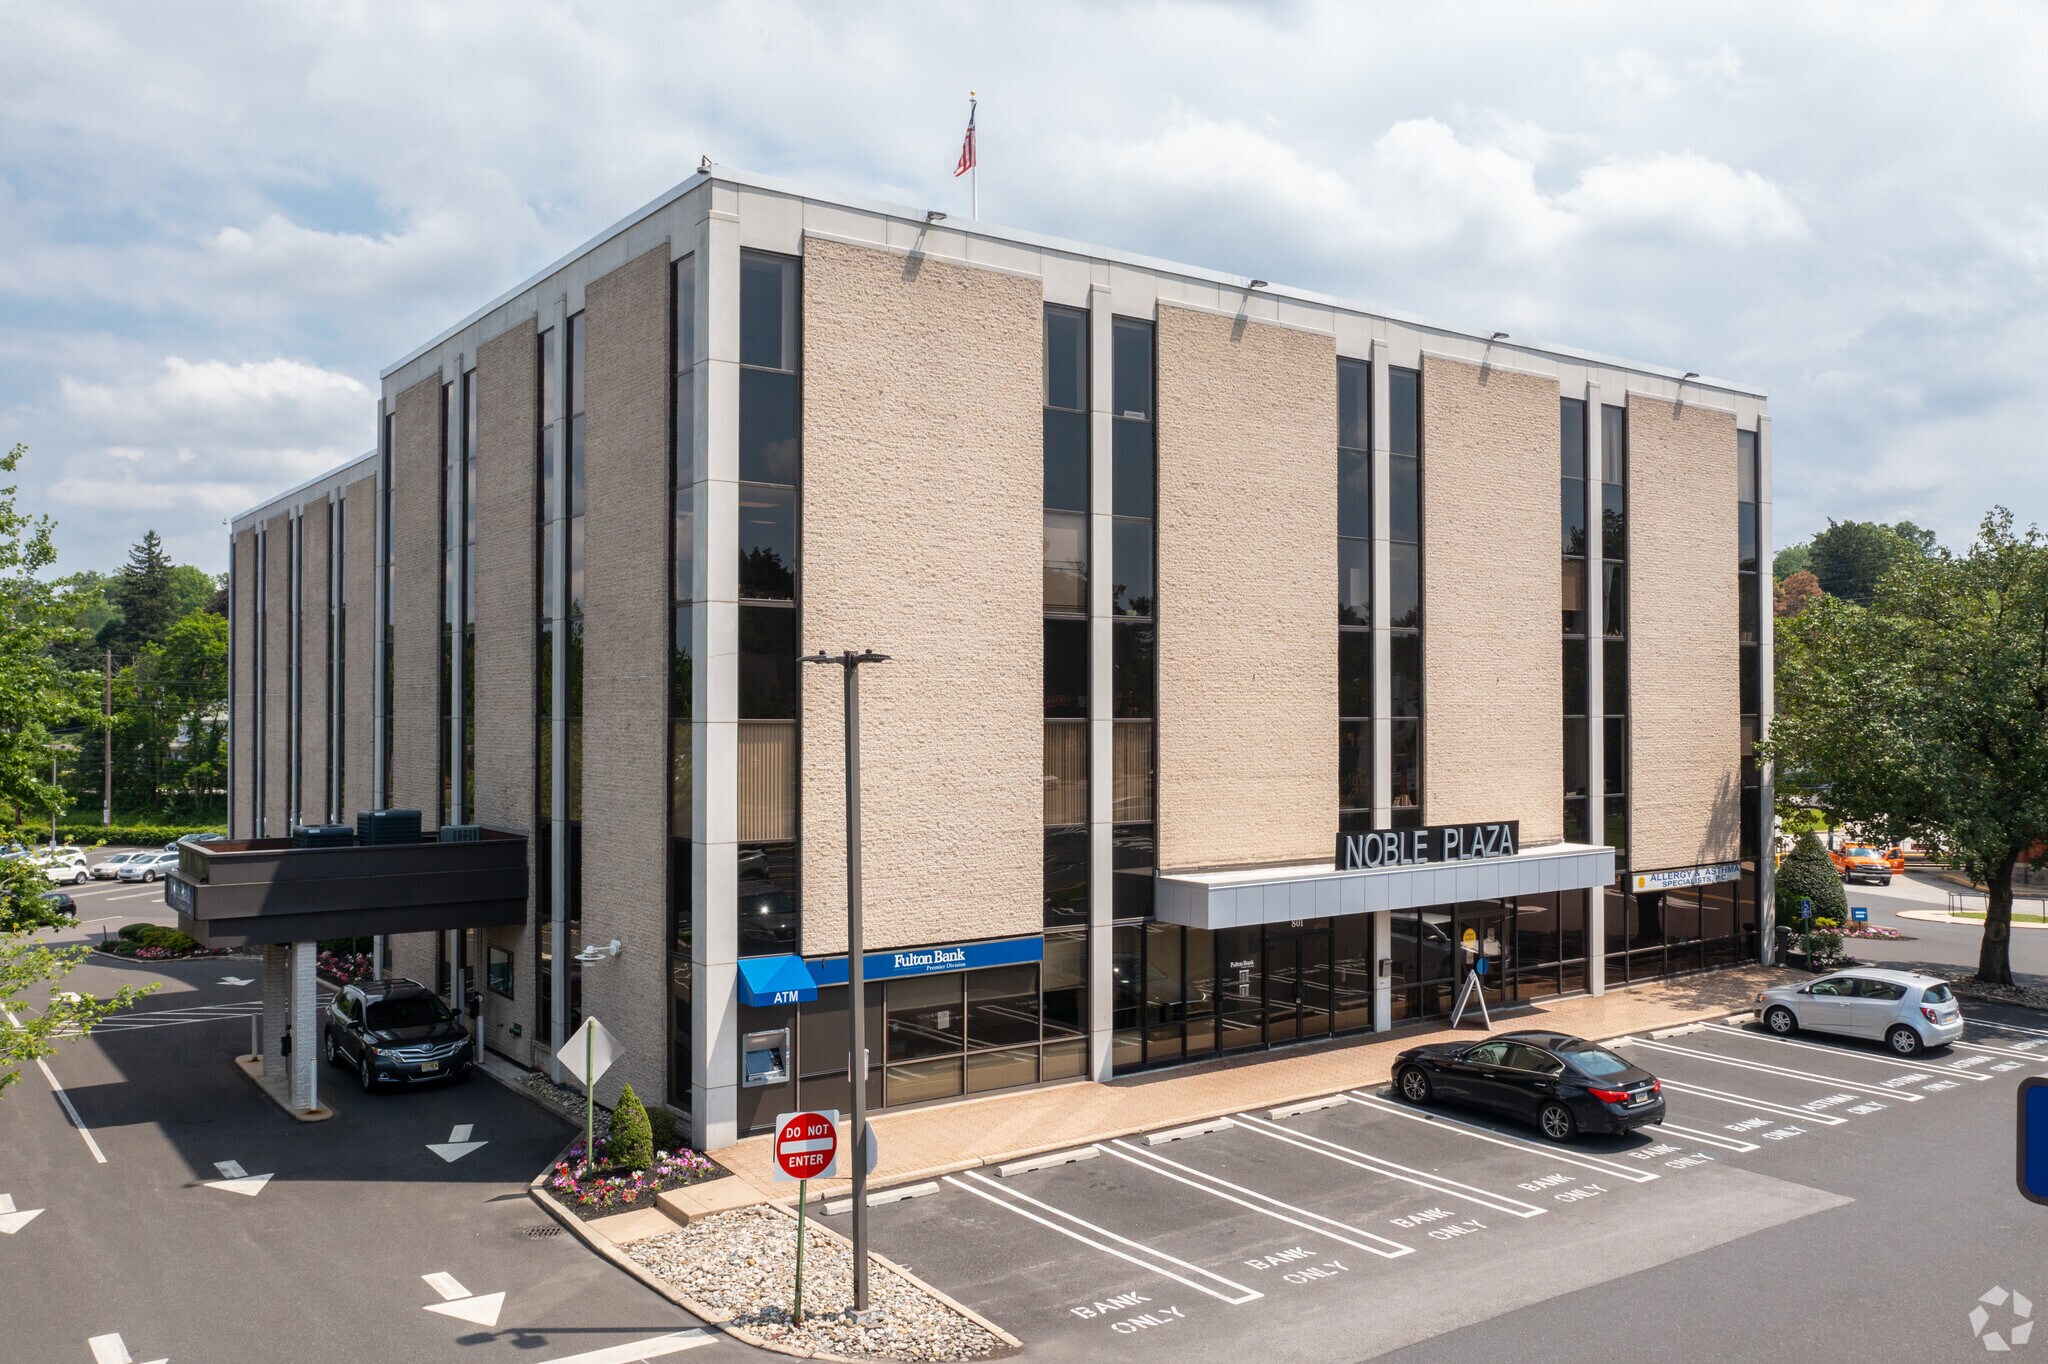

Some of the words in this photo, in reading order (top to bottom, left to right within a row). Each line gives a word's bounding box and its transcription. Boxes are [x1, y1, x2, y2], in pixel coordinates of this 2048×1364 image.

[1346, 830, 1429, 870] NOBLE
[1443, 824, 1515, 861] PLAZA
[1650, 869, 1692, 882] ALLERGY
[1694, 869, 1701, 877] &
[1705, 865, 1740, 875] ASTHMA
[894, 953, 932, 968] Fulton
[934, 948, 966, 963] Bank
[773, 990, 799, 1004] ATM
[1922, 1079, 1961, 1092] ONLY
[1800, 1093, 1860, 1111] ASTHMA
[1846, 1101, 1889, 1115] ONLY
[786, 1126, 801, 1139] DO
[808, 1124, 829, 1136] NOT
[1724, 1117, 1775, 1132] BANK
[1762, 1125, 1808, 1140] ONLY
[1628, 1143, 1682, 1160] BANK
[1665, 1152, 1715, 1169] ONLY
[789, 1154, 823, 1168] ENTER
[1517, 1172, 1576, 1192] BANK
[1554, 1183, 1608, 1203] ONLY
[1389, 1206, 1456, 1228] BANK
[1428, 1219, 1487, 1240] ONLY
[1244, 1246, 1317, 1270] BANK
[1283, 1260, 1349, 1284] ONLY
[1070, 1291, 1152, 1319] BANK
[1110, 1305, 1186, 1334] ONLY
